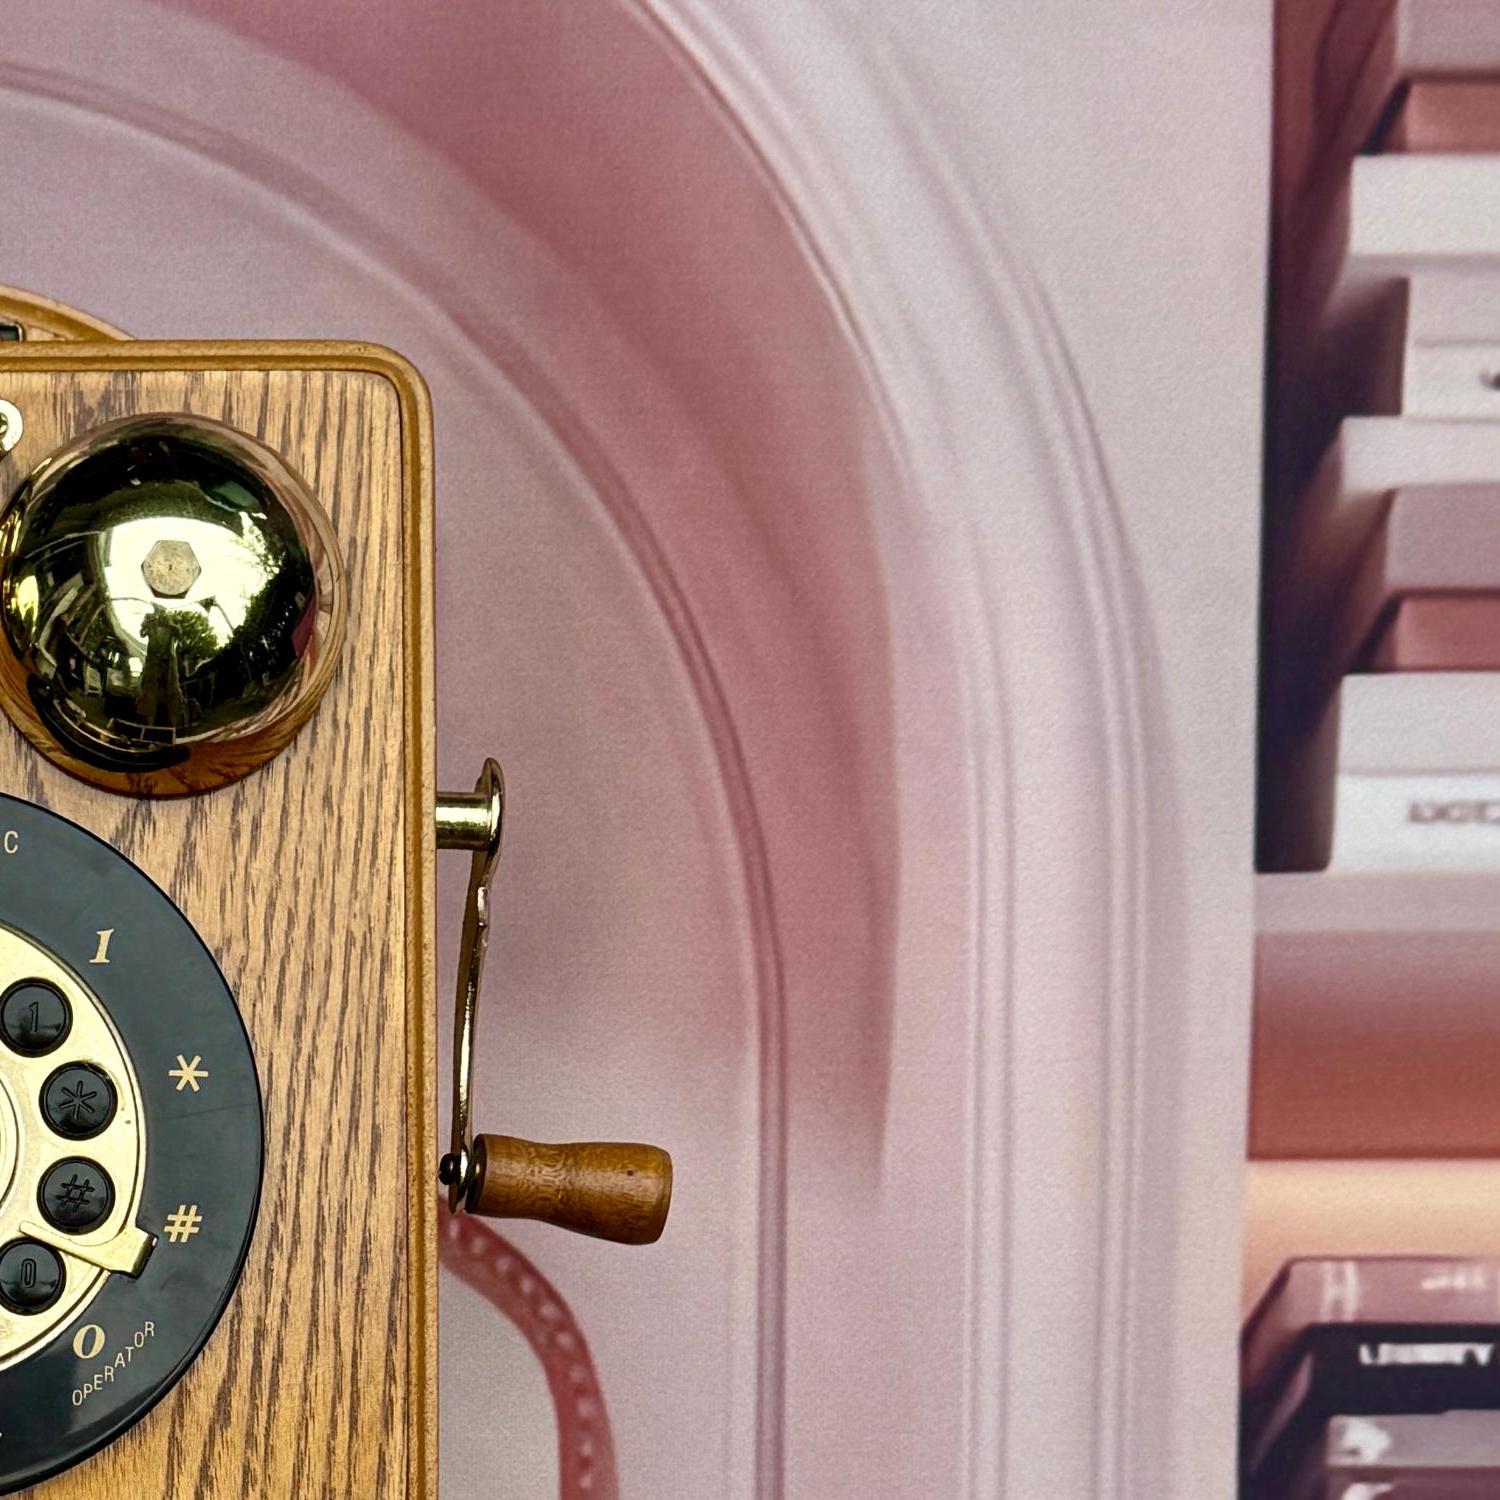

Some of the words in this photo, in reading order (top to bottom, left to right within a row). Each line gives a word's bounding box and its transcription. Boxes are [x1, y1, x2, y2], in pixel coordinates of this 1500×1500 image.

[88, 928, 115, 964] 1
[28, 1001, 39, 1033] 1
[163, 1204, 203, 1243] #
[20, 1257, 37, 1288] 0
[72, 1324, 106, 1360] 0
[71, 1320, 156, 1406] OPERATOR
